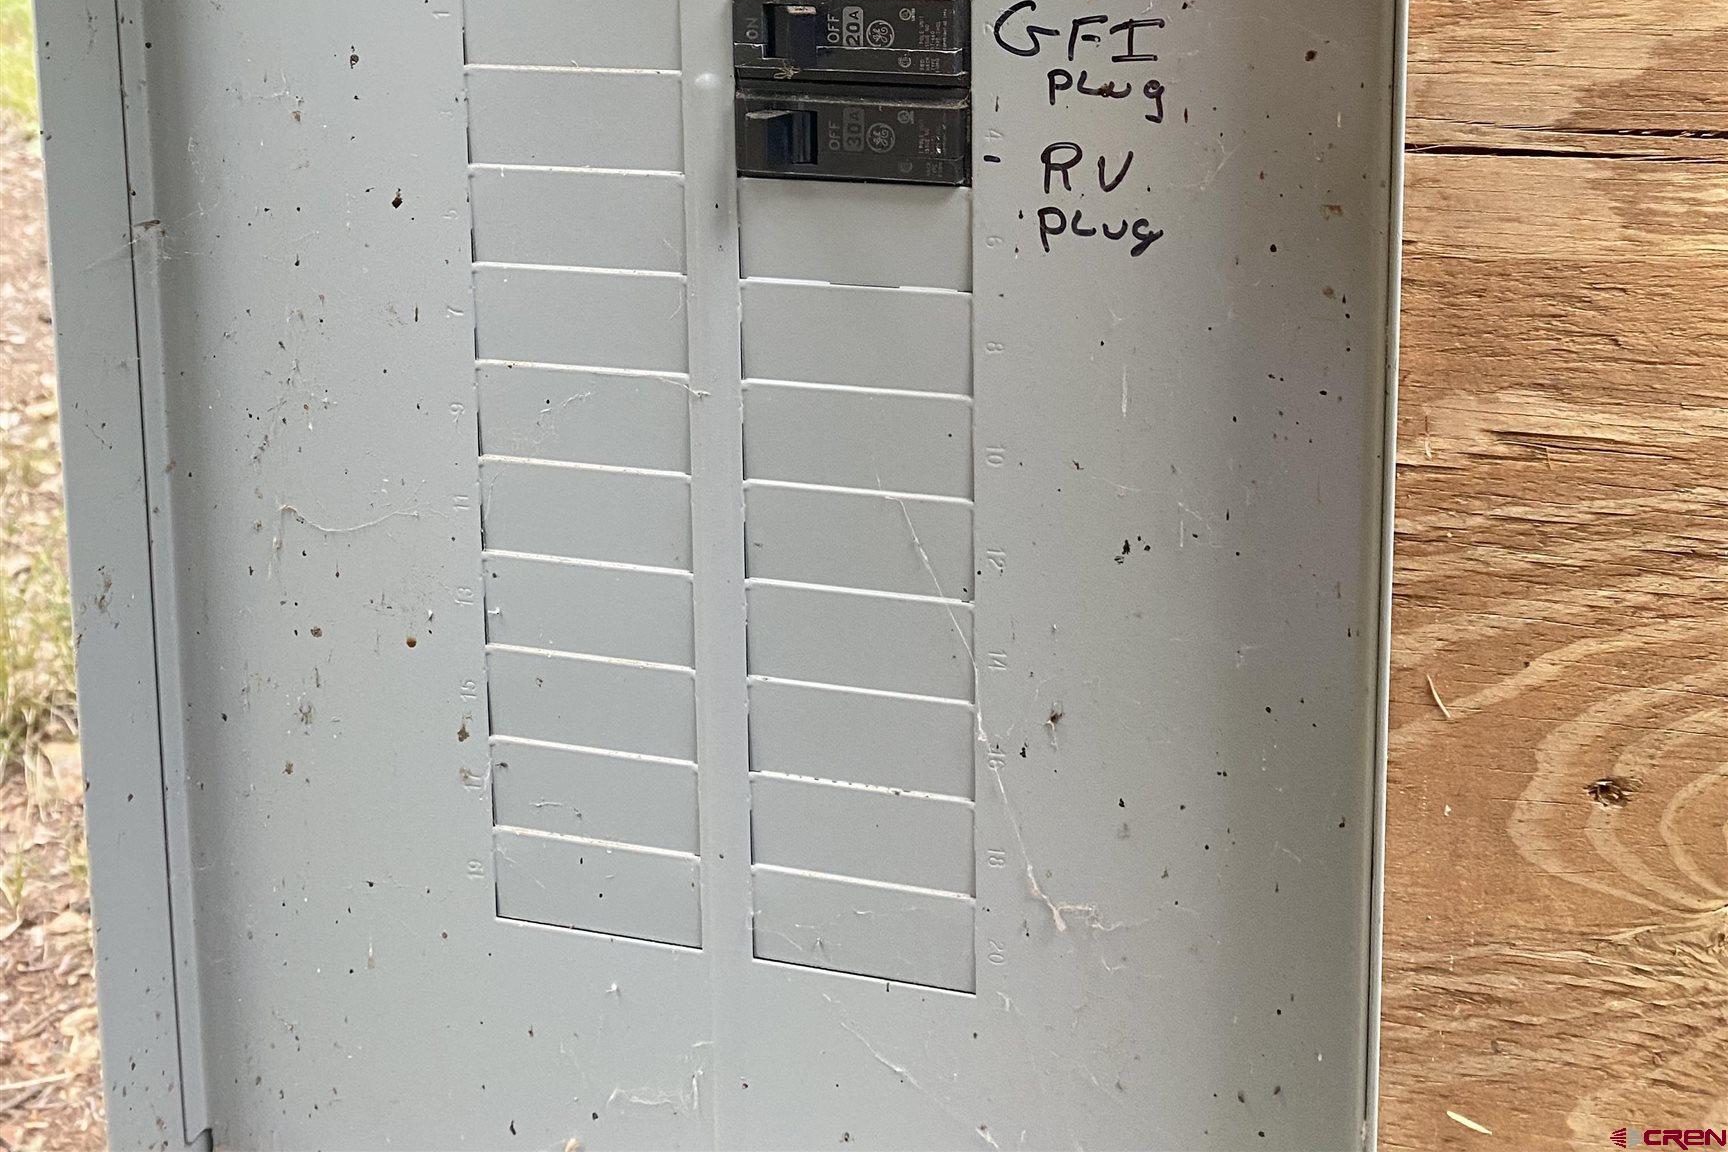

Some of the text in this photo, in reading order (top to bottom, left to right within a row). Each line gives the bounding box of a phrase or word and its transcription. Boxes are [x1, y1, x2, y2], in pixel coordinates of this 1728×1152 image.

[745, 17, 759, 40] ON
[827, 13, 840, 43] OFF
[845, 10, 861, 47] 20A
[994, 0, 1166, 62] GFI
[828, 120, 841, 151] OFF
[984, 128, 1004, 142] 4
[1040, 141, 1134, 194] RV
[986, 342, 1004, 355] 8
[986, 447, 1005, 467] 10
[453, 494, 471, 510] 11
[986, 549, 1006, 571] 12
[454, 586, 475, 606] 13
[987, 650, 1008, 671] 14
[459, 678, 477, 700] 15
[467, 859, 485, 880] 19
[987, 849, 1006, 868] 18
[987, 938, 1006, 965] 20
